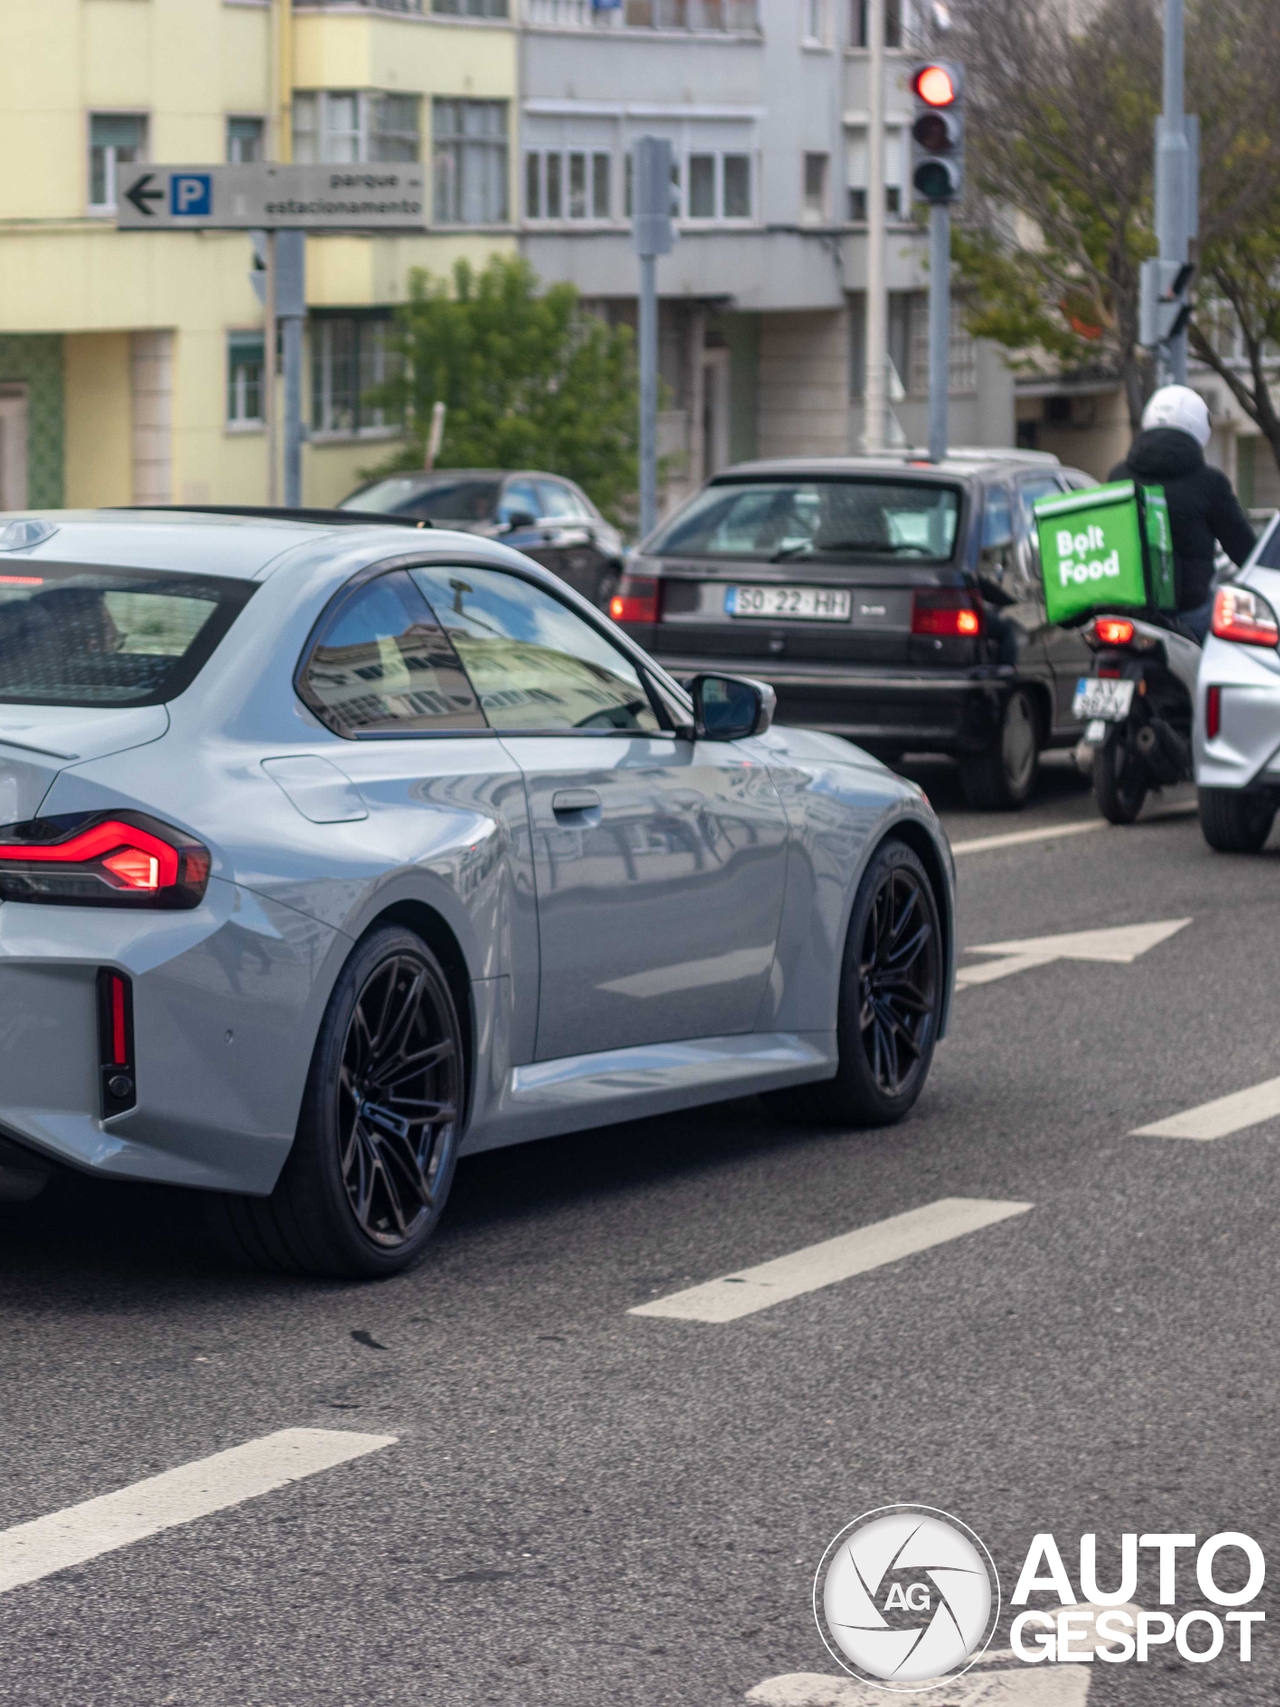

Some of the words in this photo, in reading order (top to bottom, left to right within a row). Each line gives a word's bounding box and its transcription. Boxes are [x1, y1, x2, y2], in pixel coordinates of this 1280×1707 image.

[177, 179, 204, 211] P
[330, 174, 400, 189] parque
[265, 198, 422, 214] estacionamento
[1056, 524, 1106, 558] Bolt
[1059, 549, 1120, 587] Food
